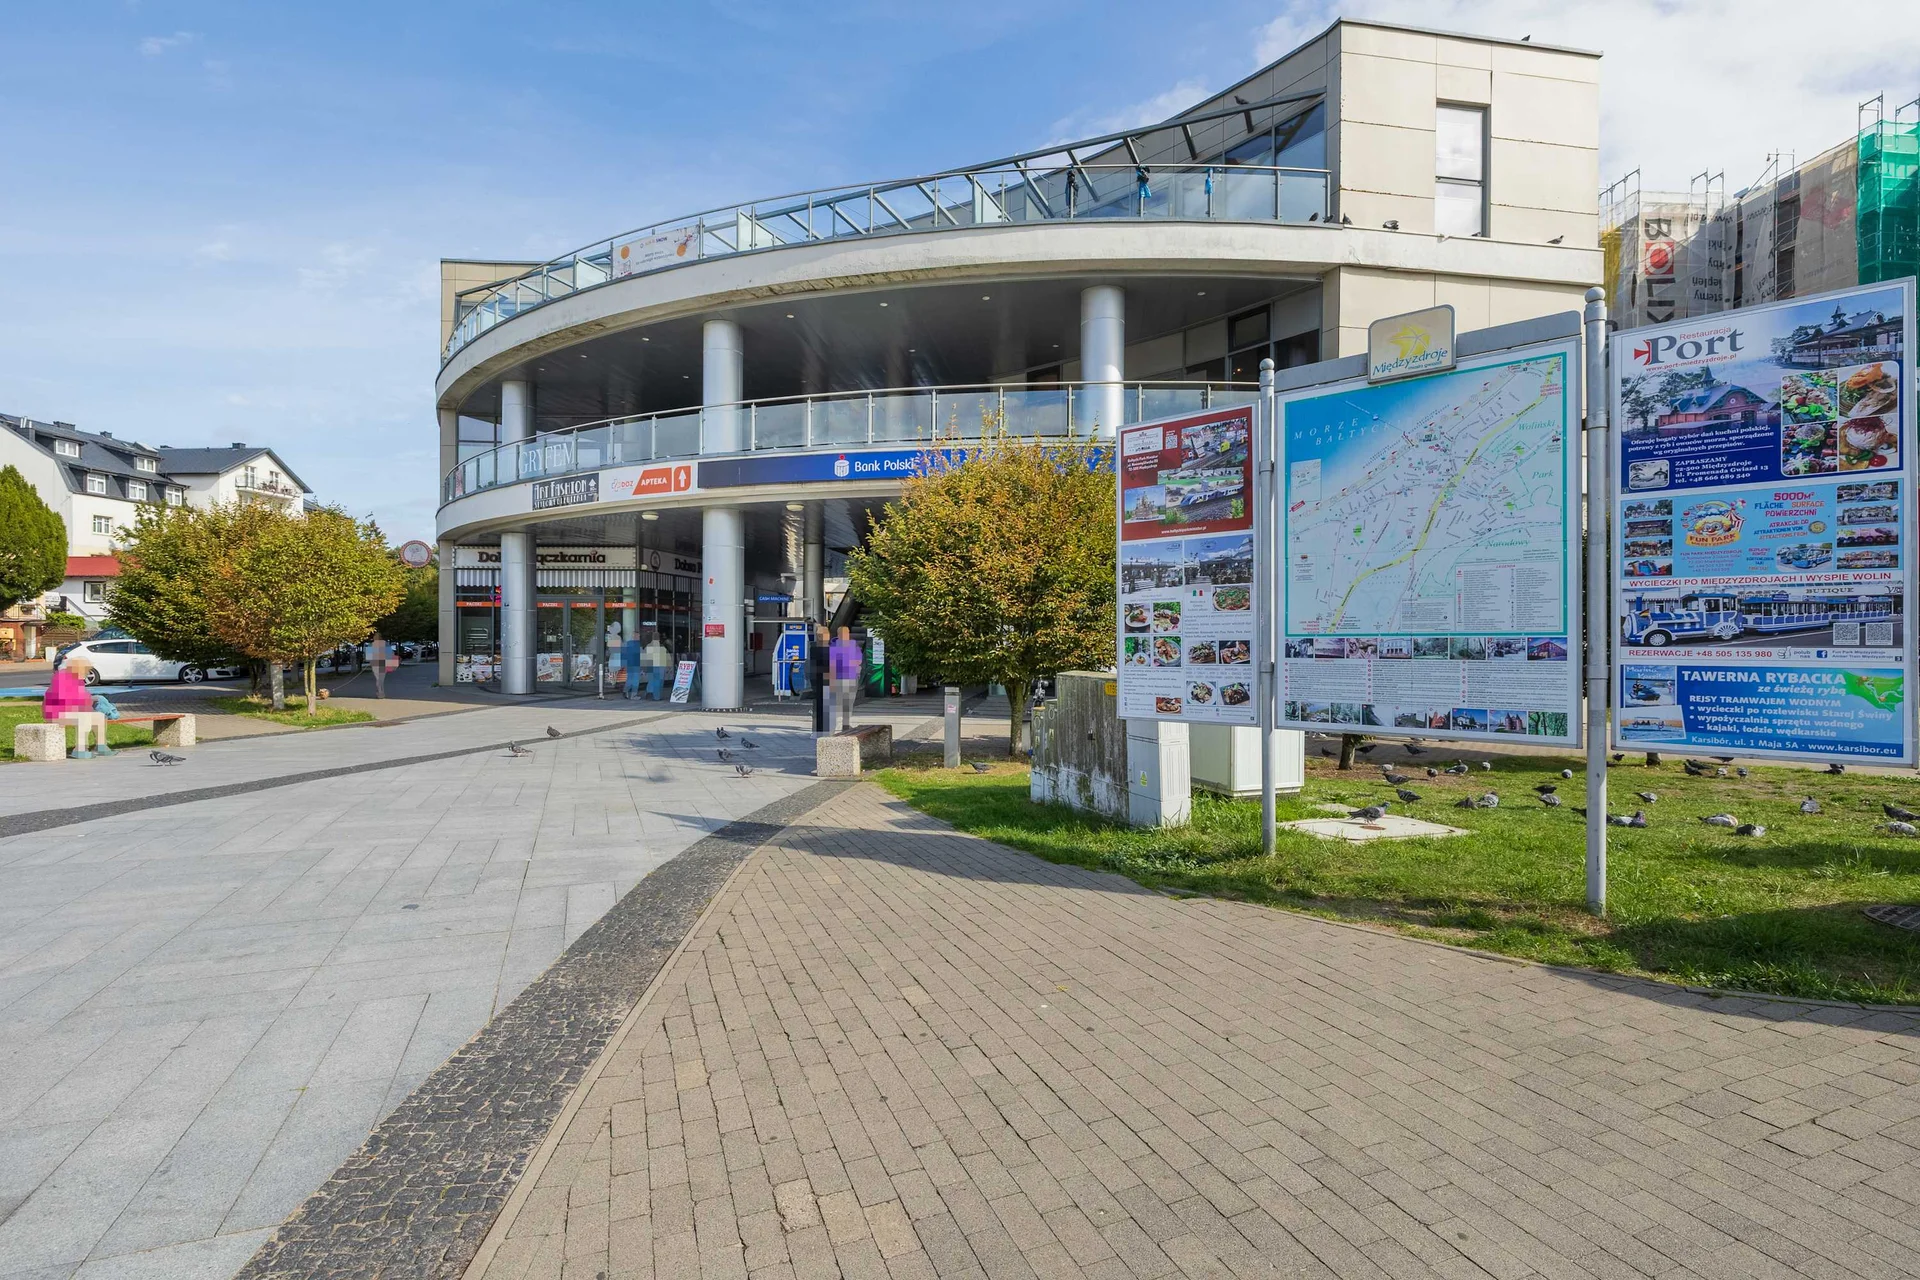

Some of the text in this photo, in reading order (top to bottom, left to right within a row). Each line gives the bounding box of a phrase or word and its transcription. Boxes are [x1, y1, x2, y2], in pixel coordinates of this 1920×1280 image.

[1692, 276, 1722, 288] iepleń
[1694, 290, 1723, 300] stemy
[1680, 327, 1731, 340] Restauracja
[1646, 329, 1744, 364] Port
[1373, 348, 1448, 376] Międzyzdroje
[1646, 354, 1736, 372] www.port-miedzyzdroje.pl
[1293, 418, 1358, 440] MORZE
[1518, 420, 1556, 431] Woliński
[1628, 444, 1653, 452] potrawy
[1729, 431, 1774, 441] sporządzone
[1631, 438, 1655, 446] Oferuję
[1656, 436, 1677, 444] bogaty
[1664, 444, 1706, 454] oryginalnych
[1707, 442, 1745, 450] przepisów.
[519, 442, 576, 474] GRYFEM
[1675, 456, 1727, 465] ZAPRASZAMY
[854, 458, 914, 472] Bank Polski
[1702, 460, 1752, 470] Międzyzdroje
[1532, 470, 1554, 480] Park
[1686, 468, 1728, 477] Promenada
[641, 477, 667, 486] APTEKA
[534, 480, 586, 500] ART FASHION
[1487, 539, 1530, 548] Narodowy
[1711, 534, 1736, 542] PARK
[536, 550, 606, 564] ączkarnia
[1700, 574, 1796, 585] MIĘDZYZDROJACH
[1682, 671, 1847, 685] TAWERNA RYBACKA
[1774, 684, 1814, 696] świeżą
[1818, 687, 1847, 696] rybą
[1690, 695, 1841, 707] REJSY TRAMWAJEM WODNYM
[1698, 706, 1744, 714] wycieczki
[1763, 707, 1819, 716] rozlewisku
[1822, 709, 1854, 720] Starej
[1858, 710, 1893, 721] Świny
[1698, 714, 1864, 729] wypożyczalnia sprzętu wodnego
[1706, 724, 1837, 738] kajaki, łodzie wędkarskie
[1691, 736, 1731, 746] Karsibór,
[1758, 740, 1782, 748] Maja
[1808, 743, 1897, 754] www.karsibor.eu
